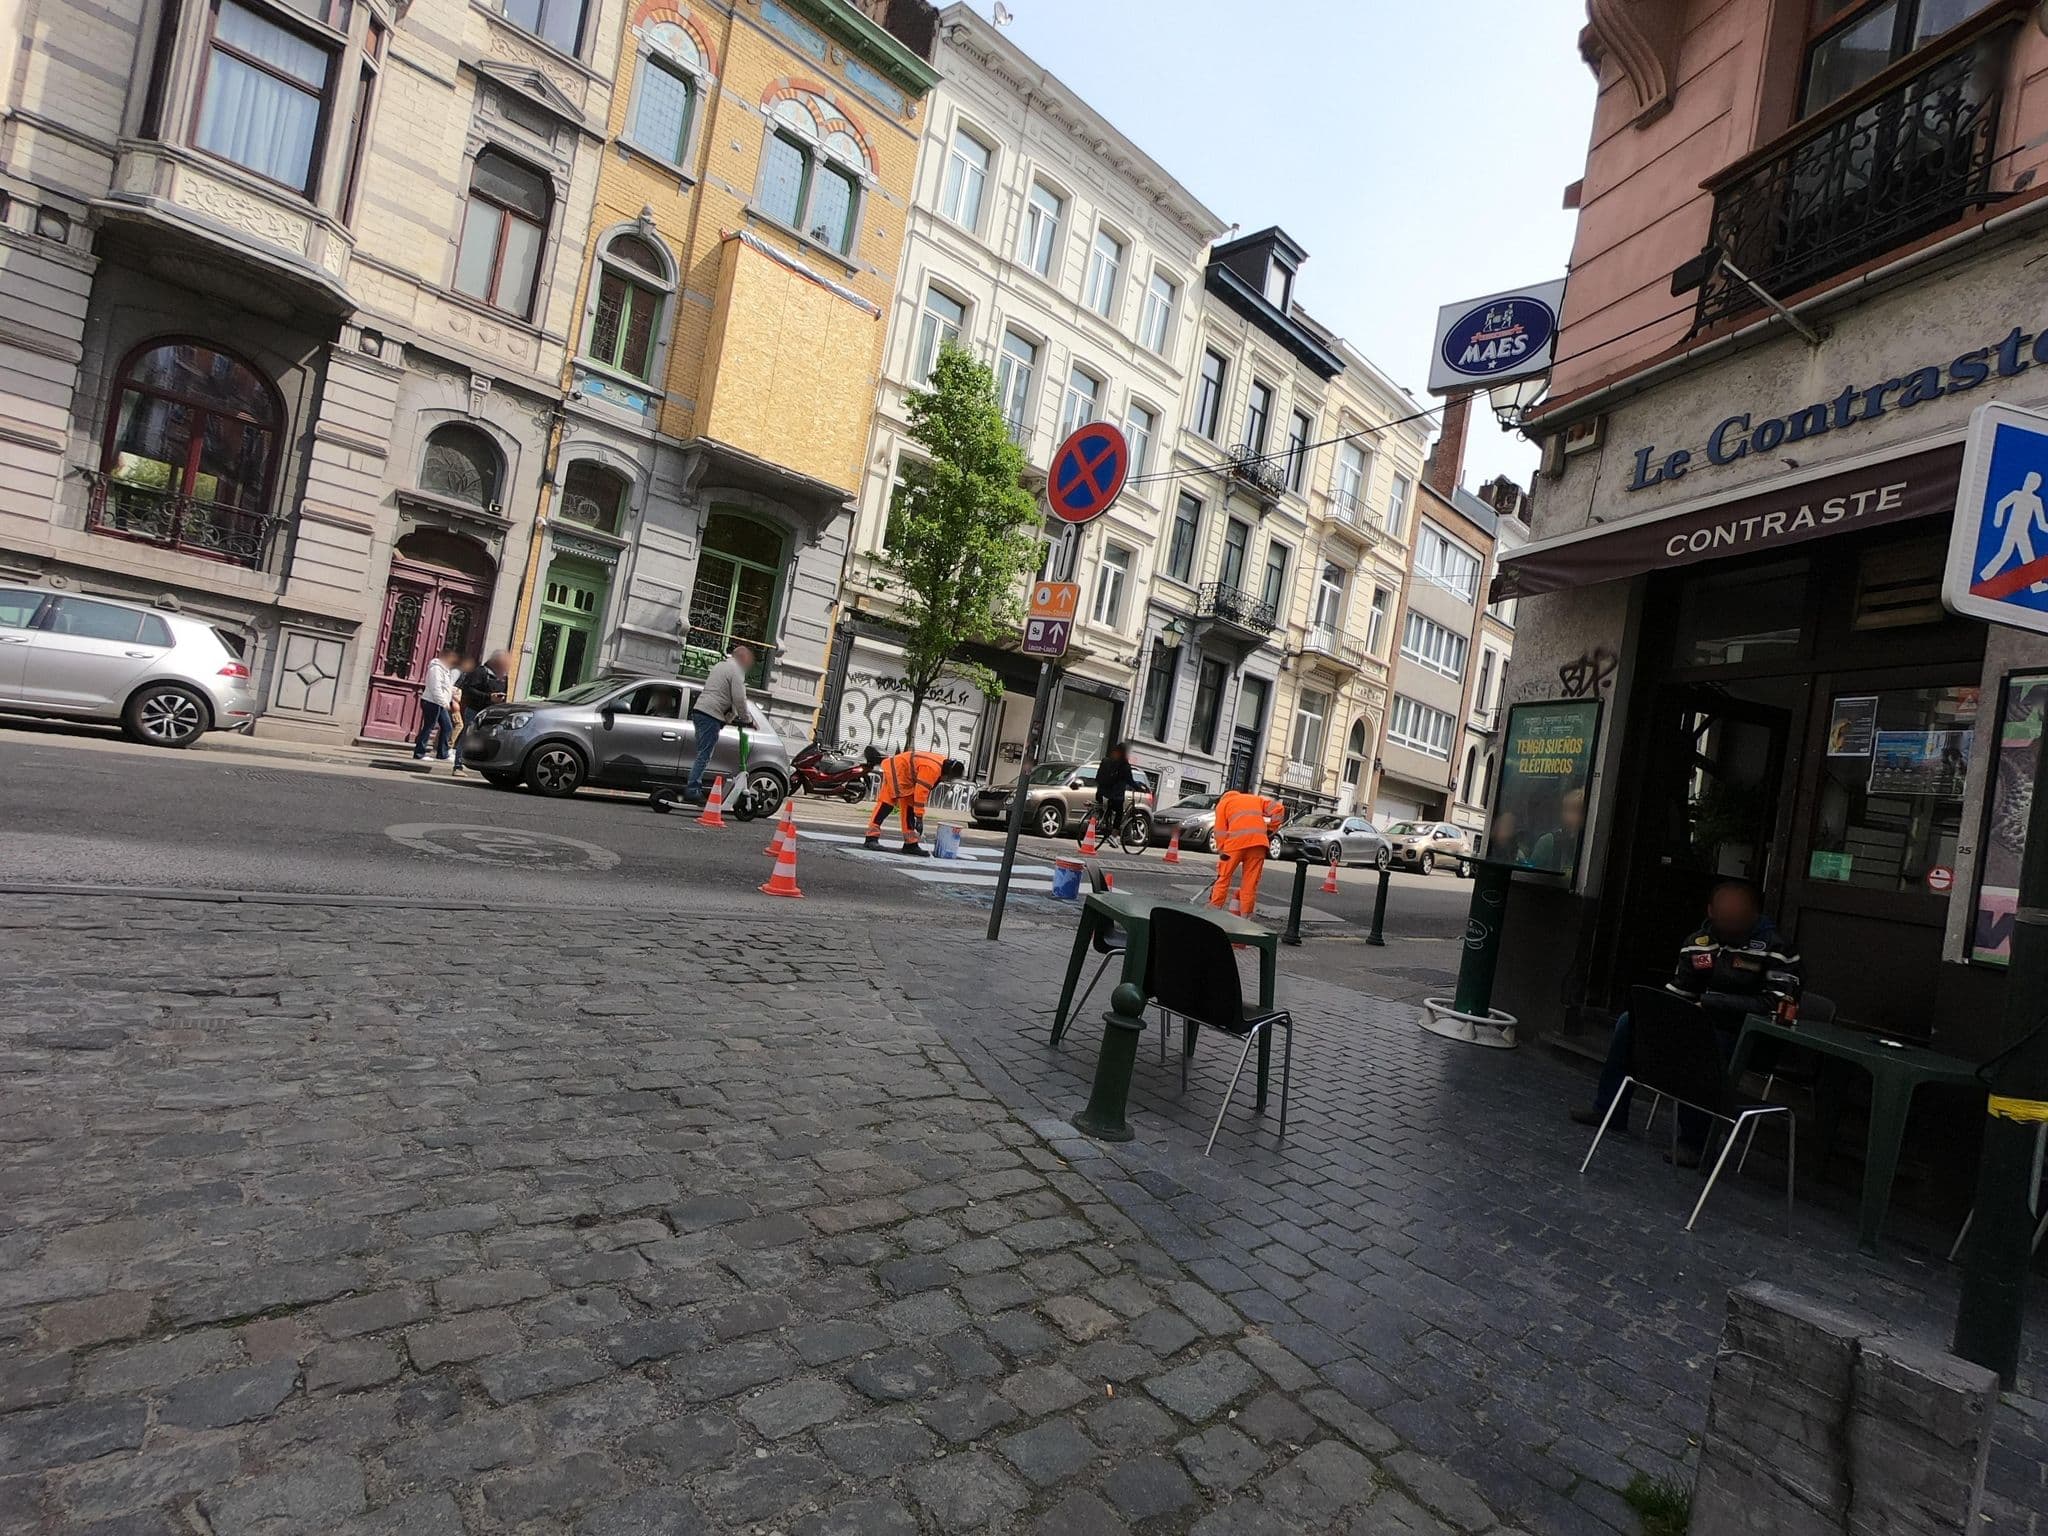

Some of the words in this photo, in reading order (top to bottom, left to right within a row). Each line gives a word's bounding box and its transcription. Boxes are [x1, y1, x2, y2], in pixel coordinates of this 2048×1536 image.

[1458, 334, 1528, 365] MAES
[1626, 445, 1690, 492] Le
[1665, 481, 1907, 557] CONTRASTE
[1517, 739, 1544, 754] TENGO
[1545, 735, 1584, 754] SUEÑOS
[1958, 845, 1973, 855] 25
